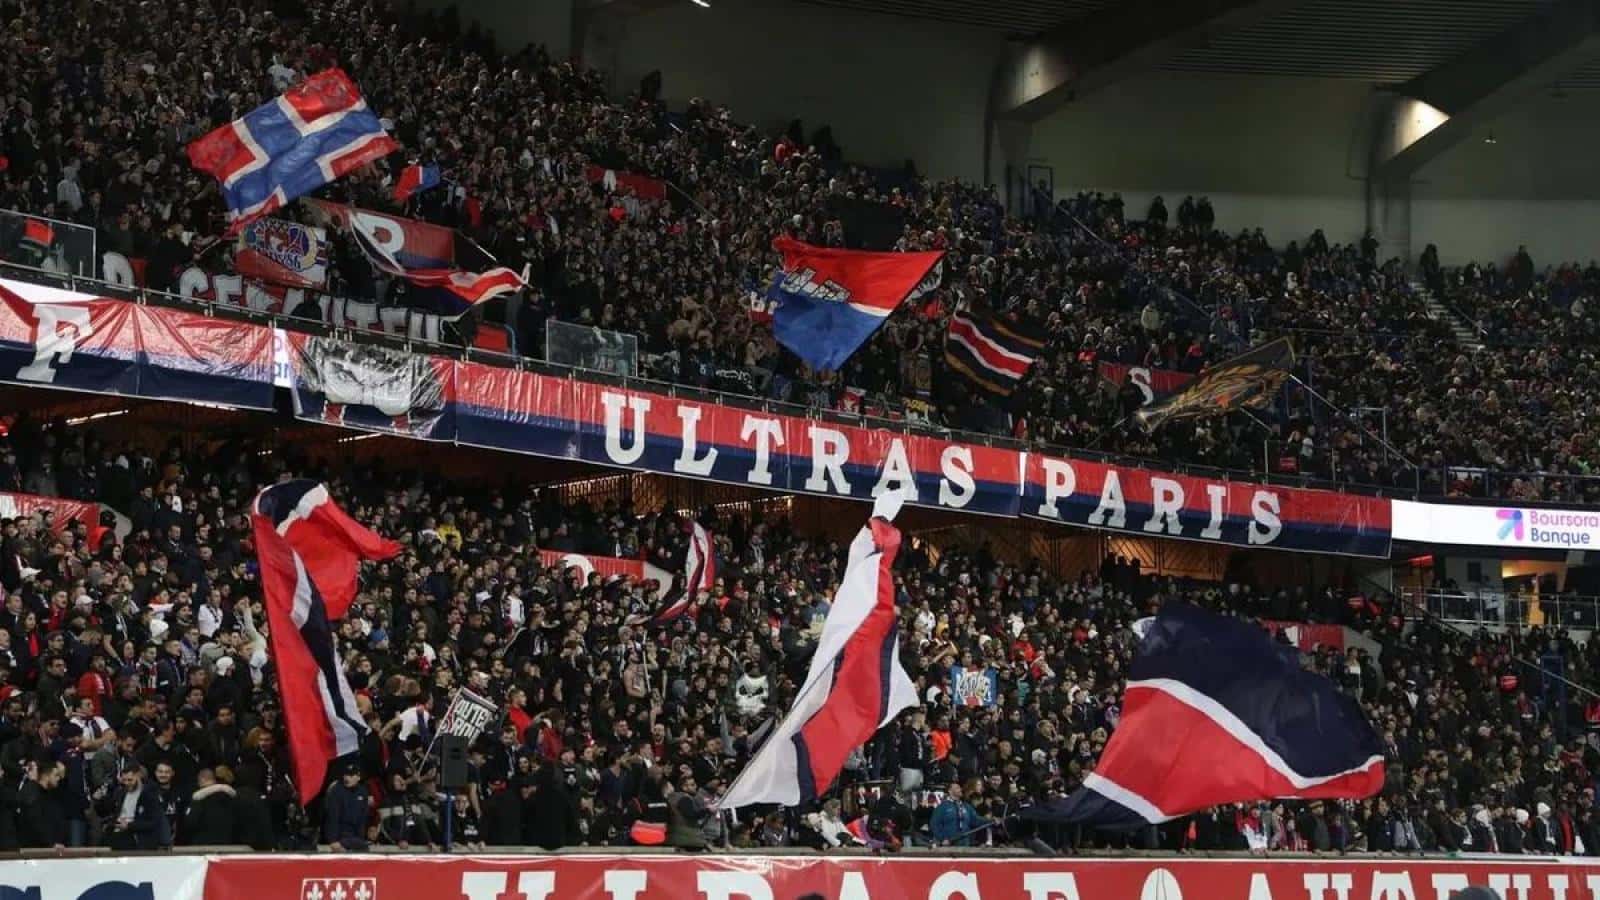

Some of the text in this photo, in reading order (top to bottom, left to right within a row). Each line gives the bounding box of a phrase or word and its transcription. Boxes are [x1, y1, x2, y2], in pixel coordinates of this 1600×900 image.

[601, 391, 1283, 545] ULTRAS PARIS
[1531, 527, 1590, 546] Banque
